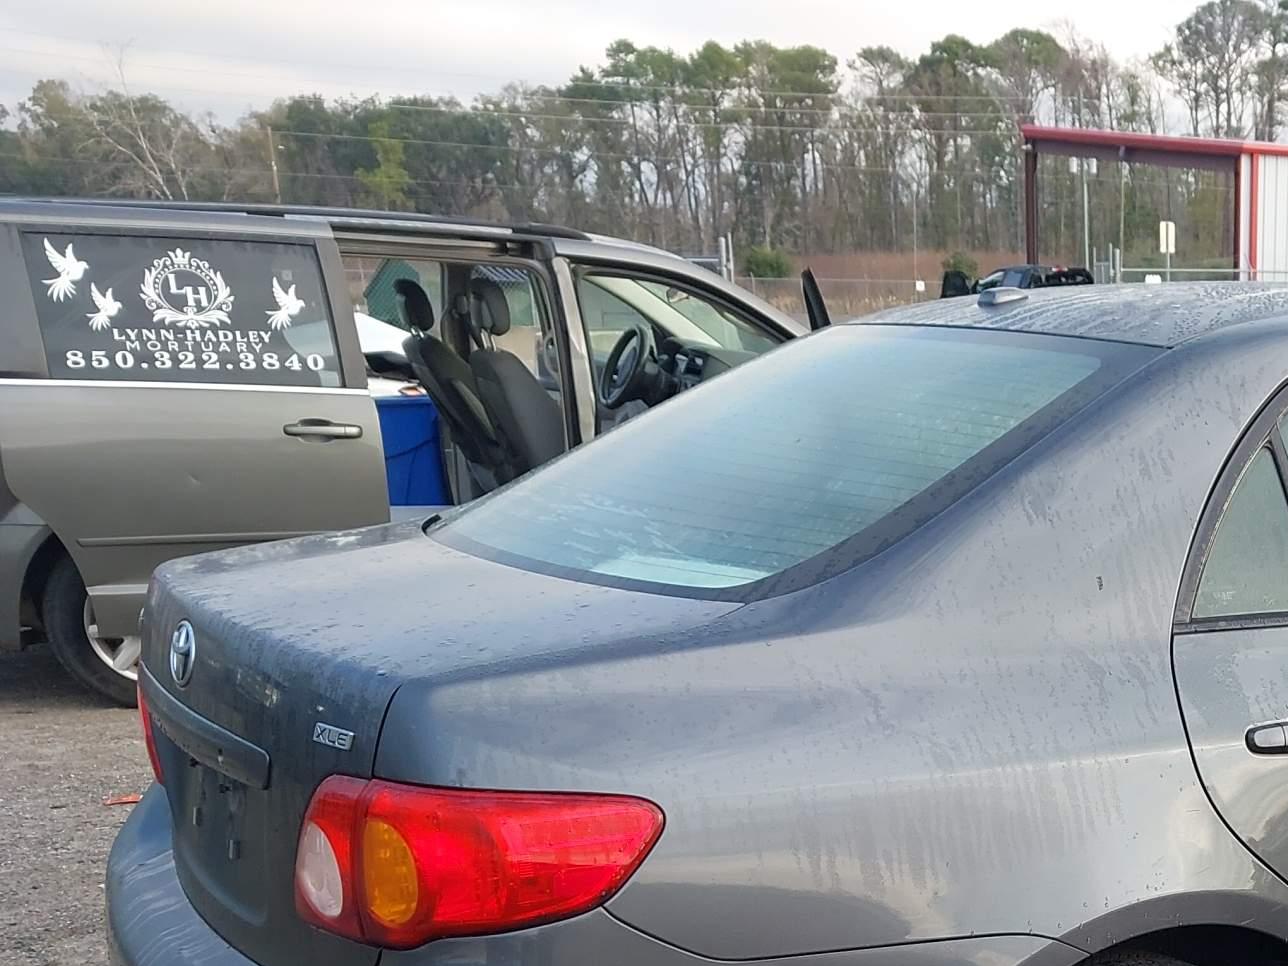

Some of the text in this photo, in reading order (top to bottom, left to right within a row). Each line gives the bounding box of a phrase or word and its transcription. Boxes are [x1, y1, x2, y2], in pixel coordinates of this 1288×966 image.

[112, 328, 272, 344] LYNN-HADLEY
[125, 340, 263, 353] MORTUARY
[65, 350, 325, 371] 850.322.3840
[313, 724, 350, 748] XLE
